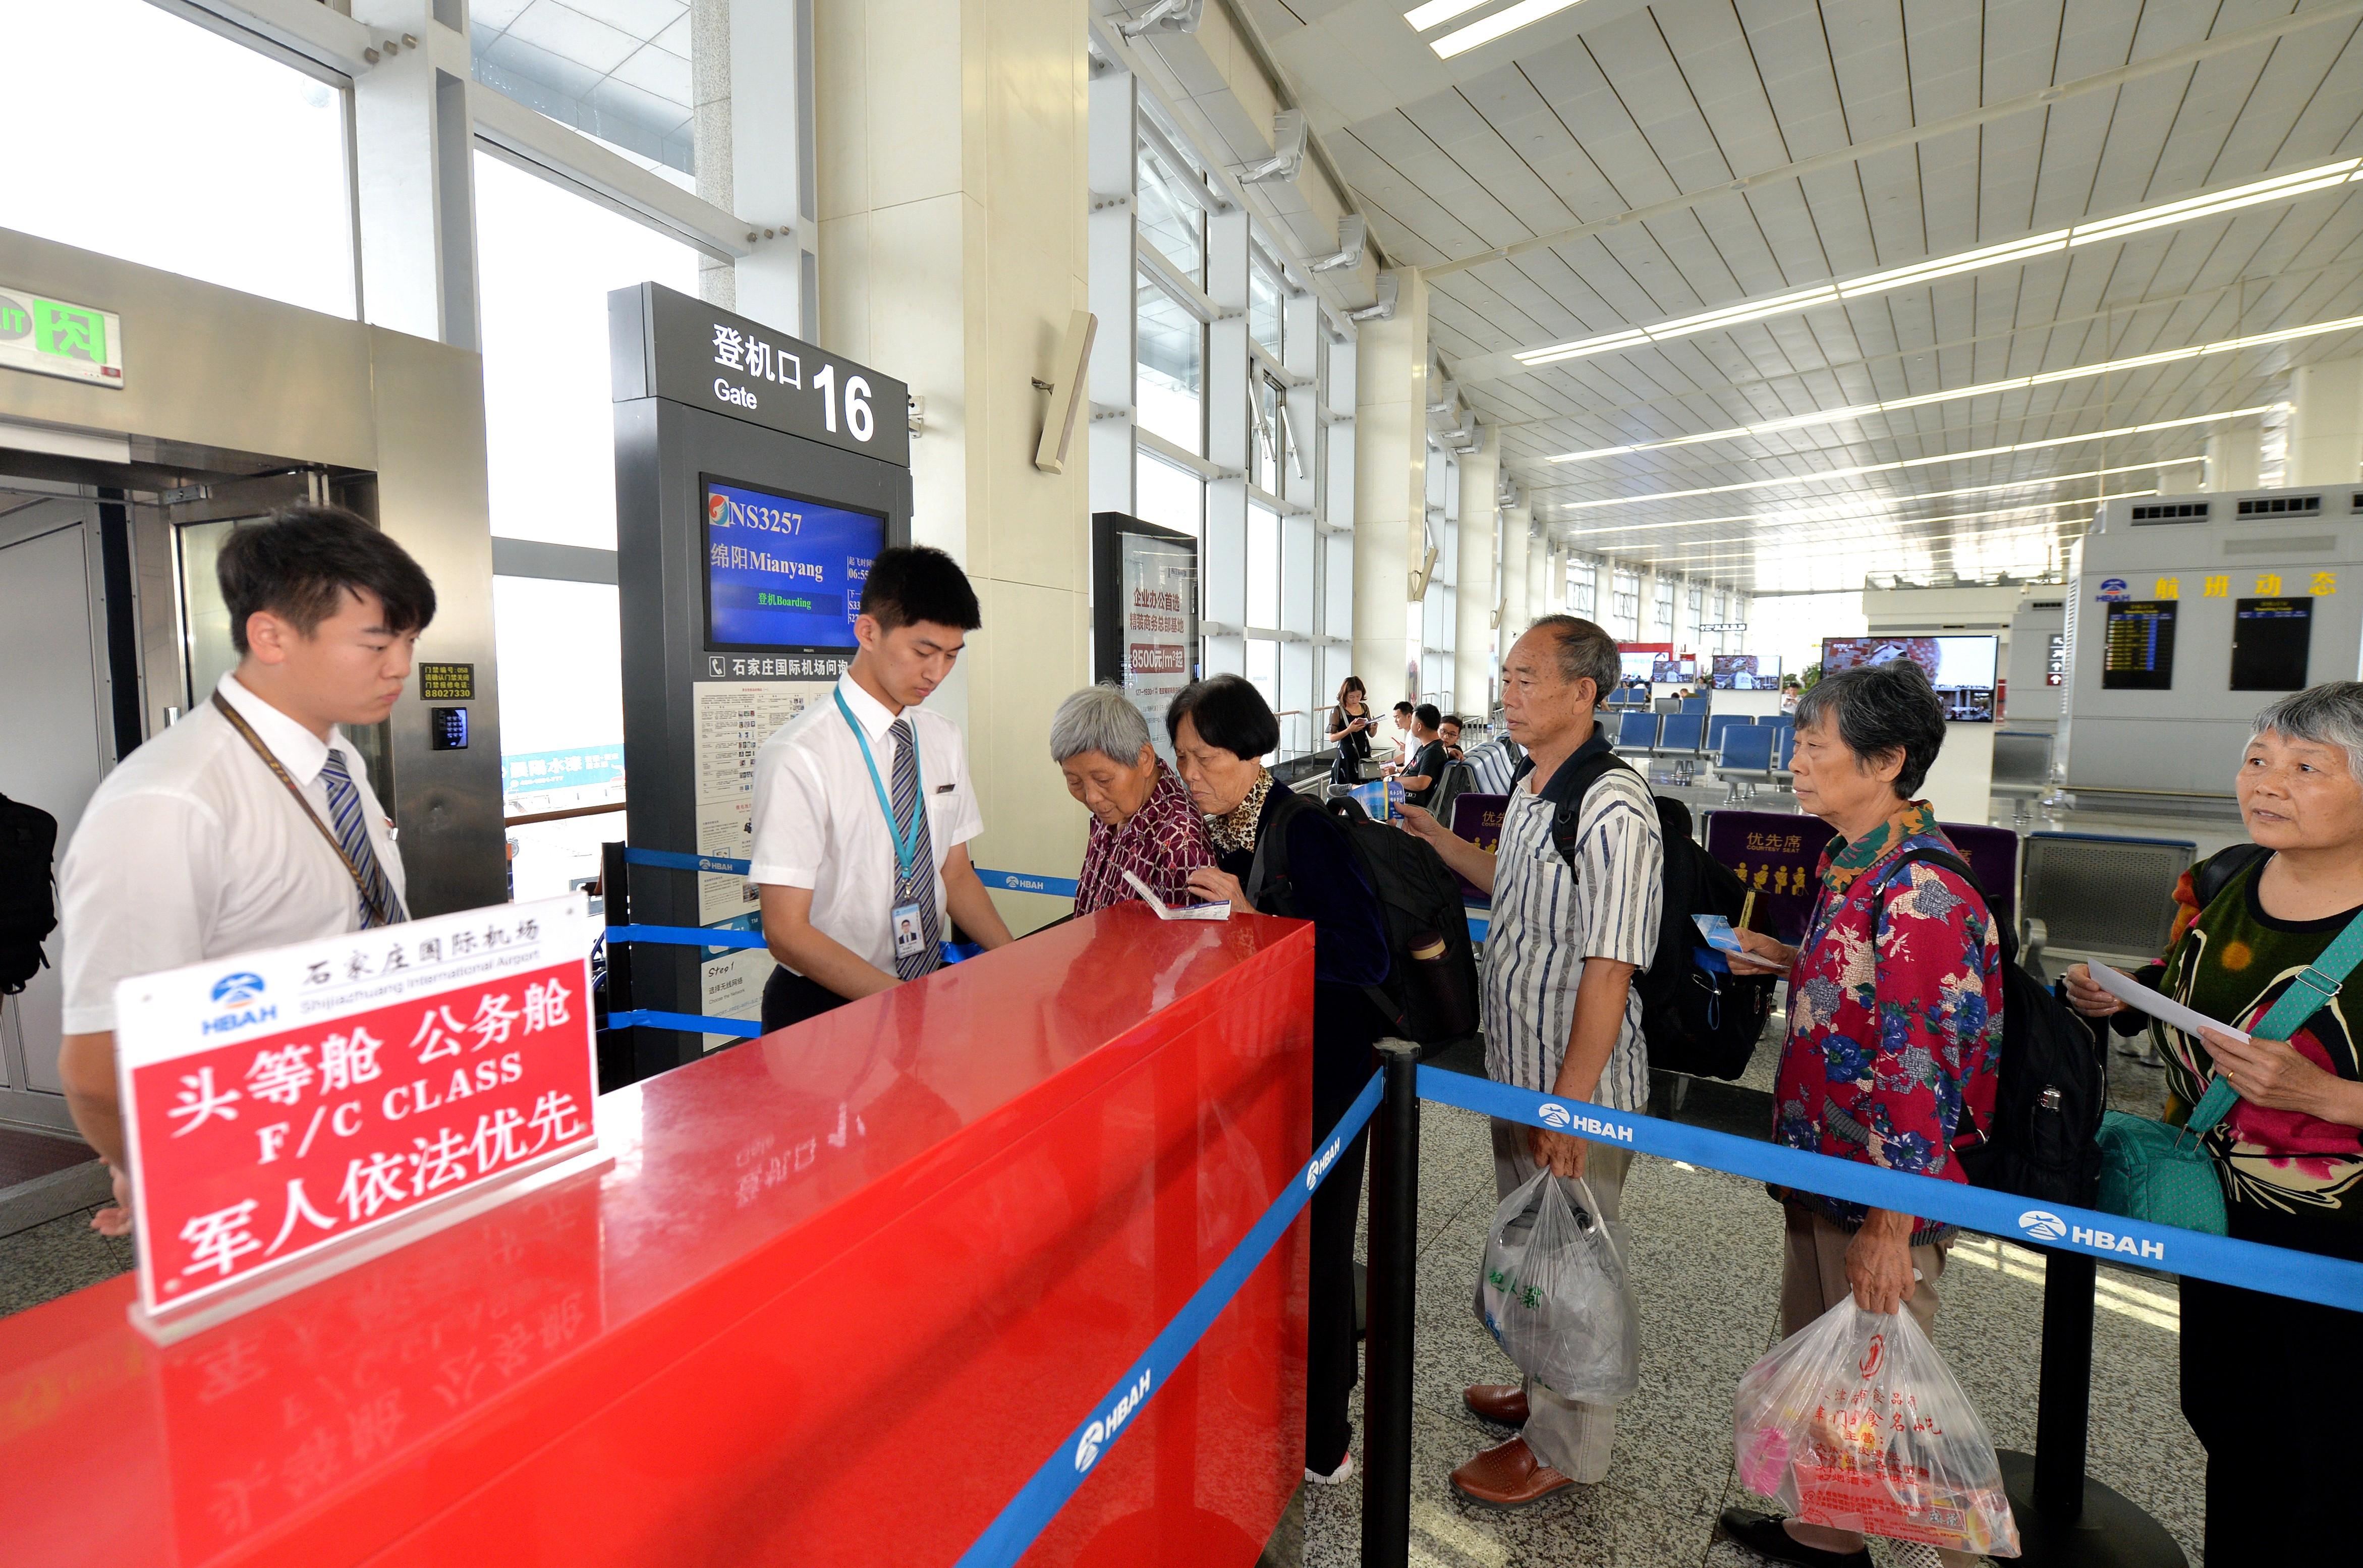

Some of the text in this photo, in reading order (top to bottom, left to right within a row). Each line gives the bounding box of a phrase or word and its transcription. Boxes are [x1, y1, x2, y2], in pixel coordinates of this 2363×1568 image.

[0, 307, 25, 333] IT
[712, 323, 801, 390] 登机口
[714, 378, 757, 410] Gate
[813, 363, 874, 442] 16
[729, 501, 802, 535] NS3257
[849, 556, 875, 568] 起飞时间
[1134, 587, 1180, 612] 企业办公首选
[2155, 572, 2337, 599] 航班动态
[1130, 612, 1184, 633] 精装商务总部基地
[1747, 832, 1802, 848] 优先席
[711, 863, 733, 871] HBAH
[1020, 880, 1043, 889] HBAH
[302, 919, 540, 986] 石家庄国际机场
[300, 949, 540, 1014] Shijiazhuang International Airport
[708, 966, 729, 977] Step
[709, 977, 743, 995] 选择无线网络
[202, 1005, 277, 1036] HBAH
[167, 977, 573, 1139] 头等舱 公务舱
[256, 1051, 524, 1165] F/C CLASS
[1573, 1115, 1633, 1142] HBAH
[1319, 1136, 1340, 1175] HBAH
[179, 1090, 582, 1276] 军人依法优先
[2072, 1216, 2164, 1260] HBAH
[1105, 1367, 1151, 1441] HBAH
